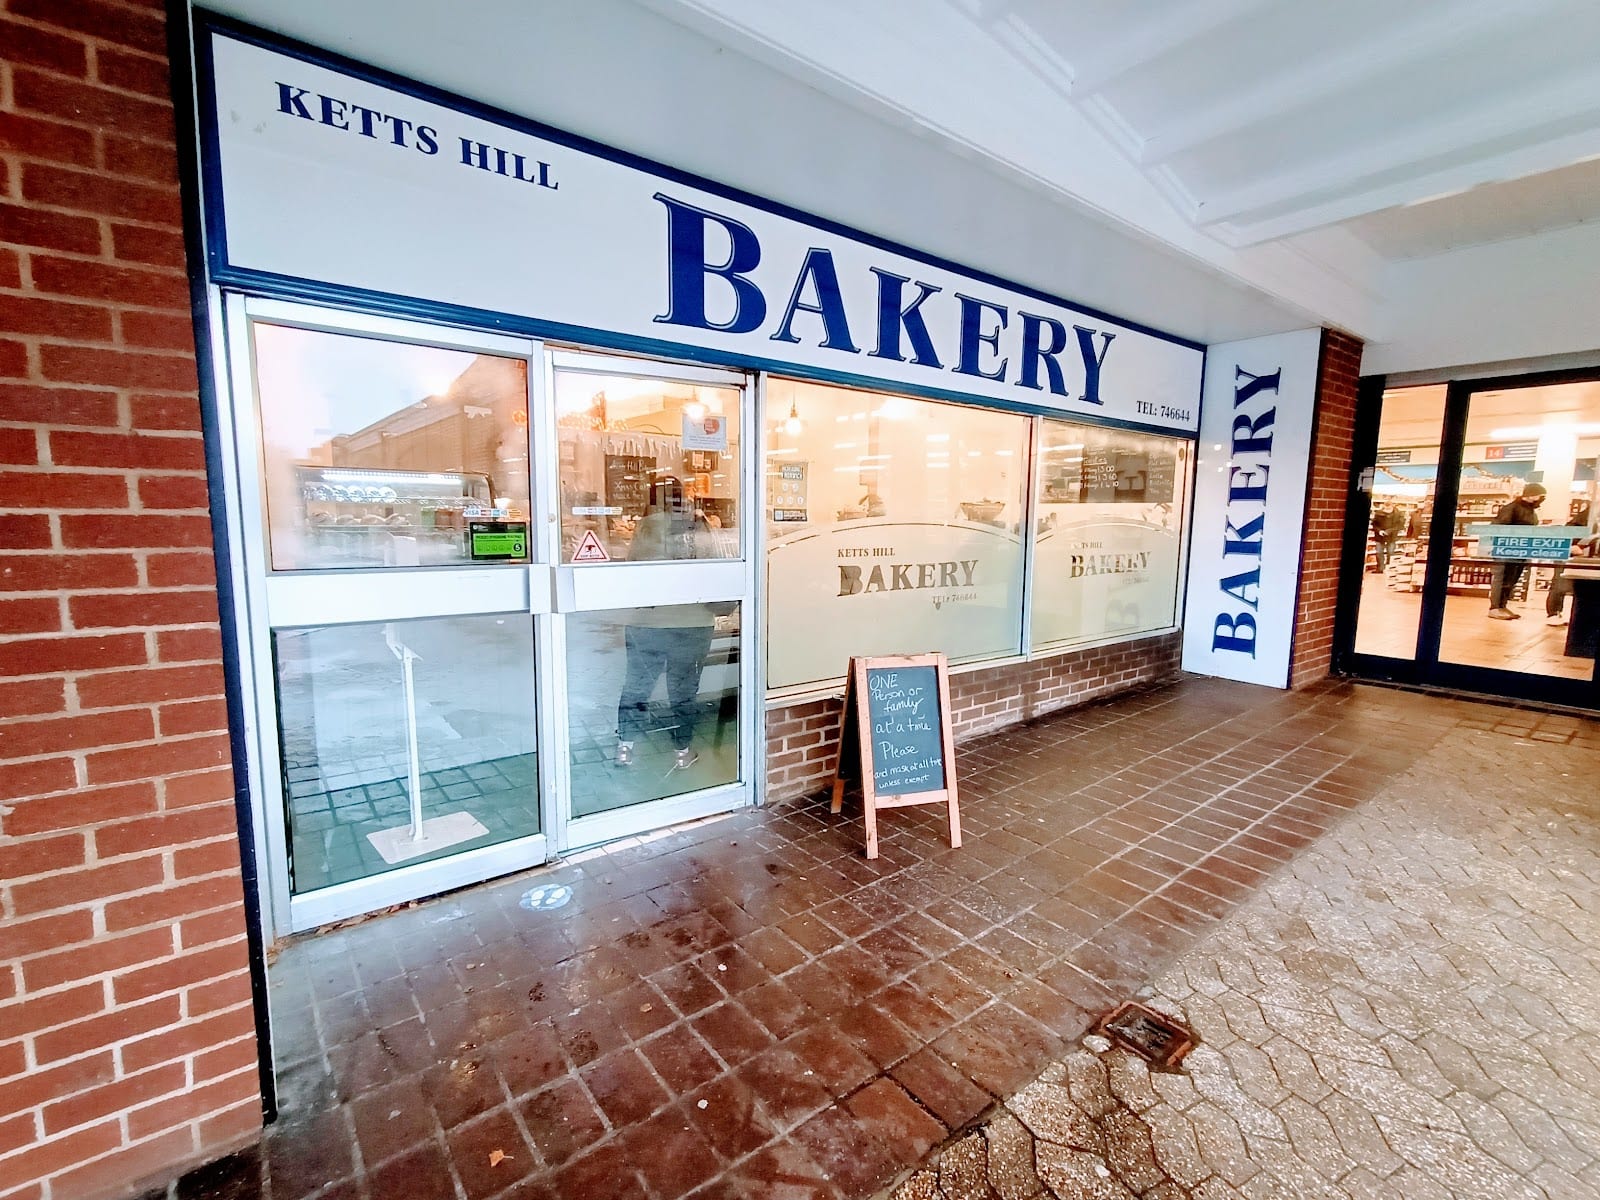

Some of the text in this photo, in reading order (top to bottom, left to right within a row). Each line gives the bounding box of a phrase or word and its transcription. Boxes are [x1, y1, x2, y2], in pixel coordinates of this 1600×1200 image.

[275, 81, 559, 190] KETTS HILL
[653, 191, 1116, 405] BAKERY
[1137, 400, 1190, 421] TEL: 746644
[1211, 364, 1282, 661] BAKERY
[838, 547, 896, 558] KETTS HILL
[1496, 546, 1564, 557] Keep clear
[1497, 538, 1565, 548] FIRE EXIT
[1070, 551, 1152, 578] BAKERY
[837, 560, 979, 597] BAKERY
[870, 673, 899, 690] ONE
[909, 687, 923, 696] or
[883, 696, 924, 715] family
[876, 716, 894, 734] at
[896, 723, 905, 733] a
[879, 740, 919, 760] Please
